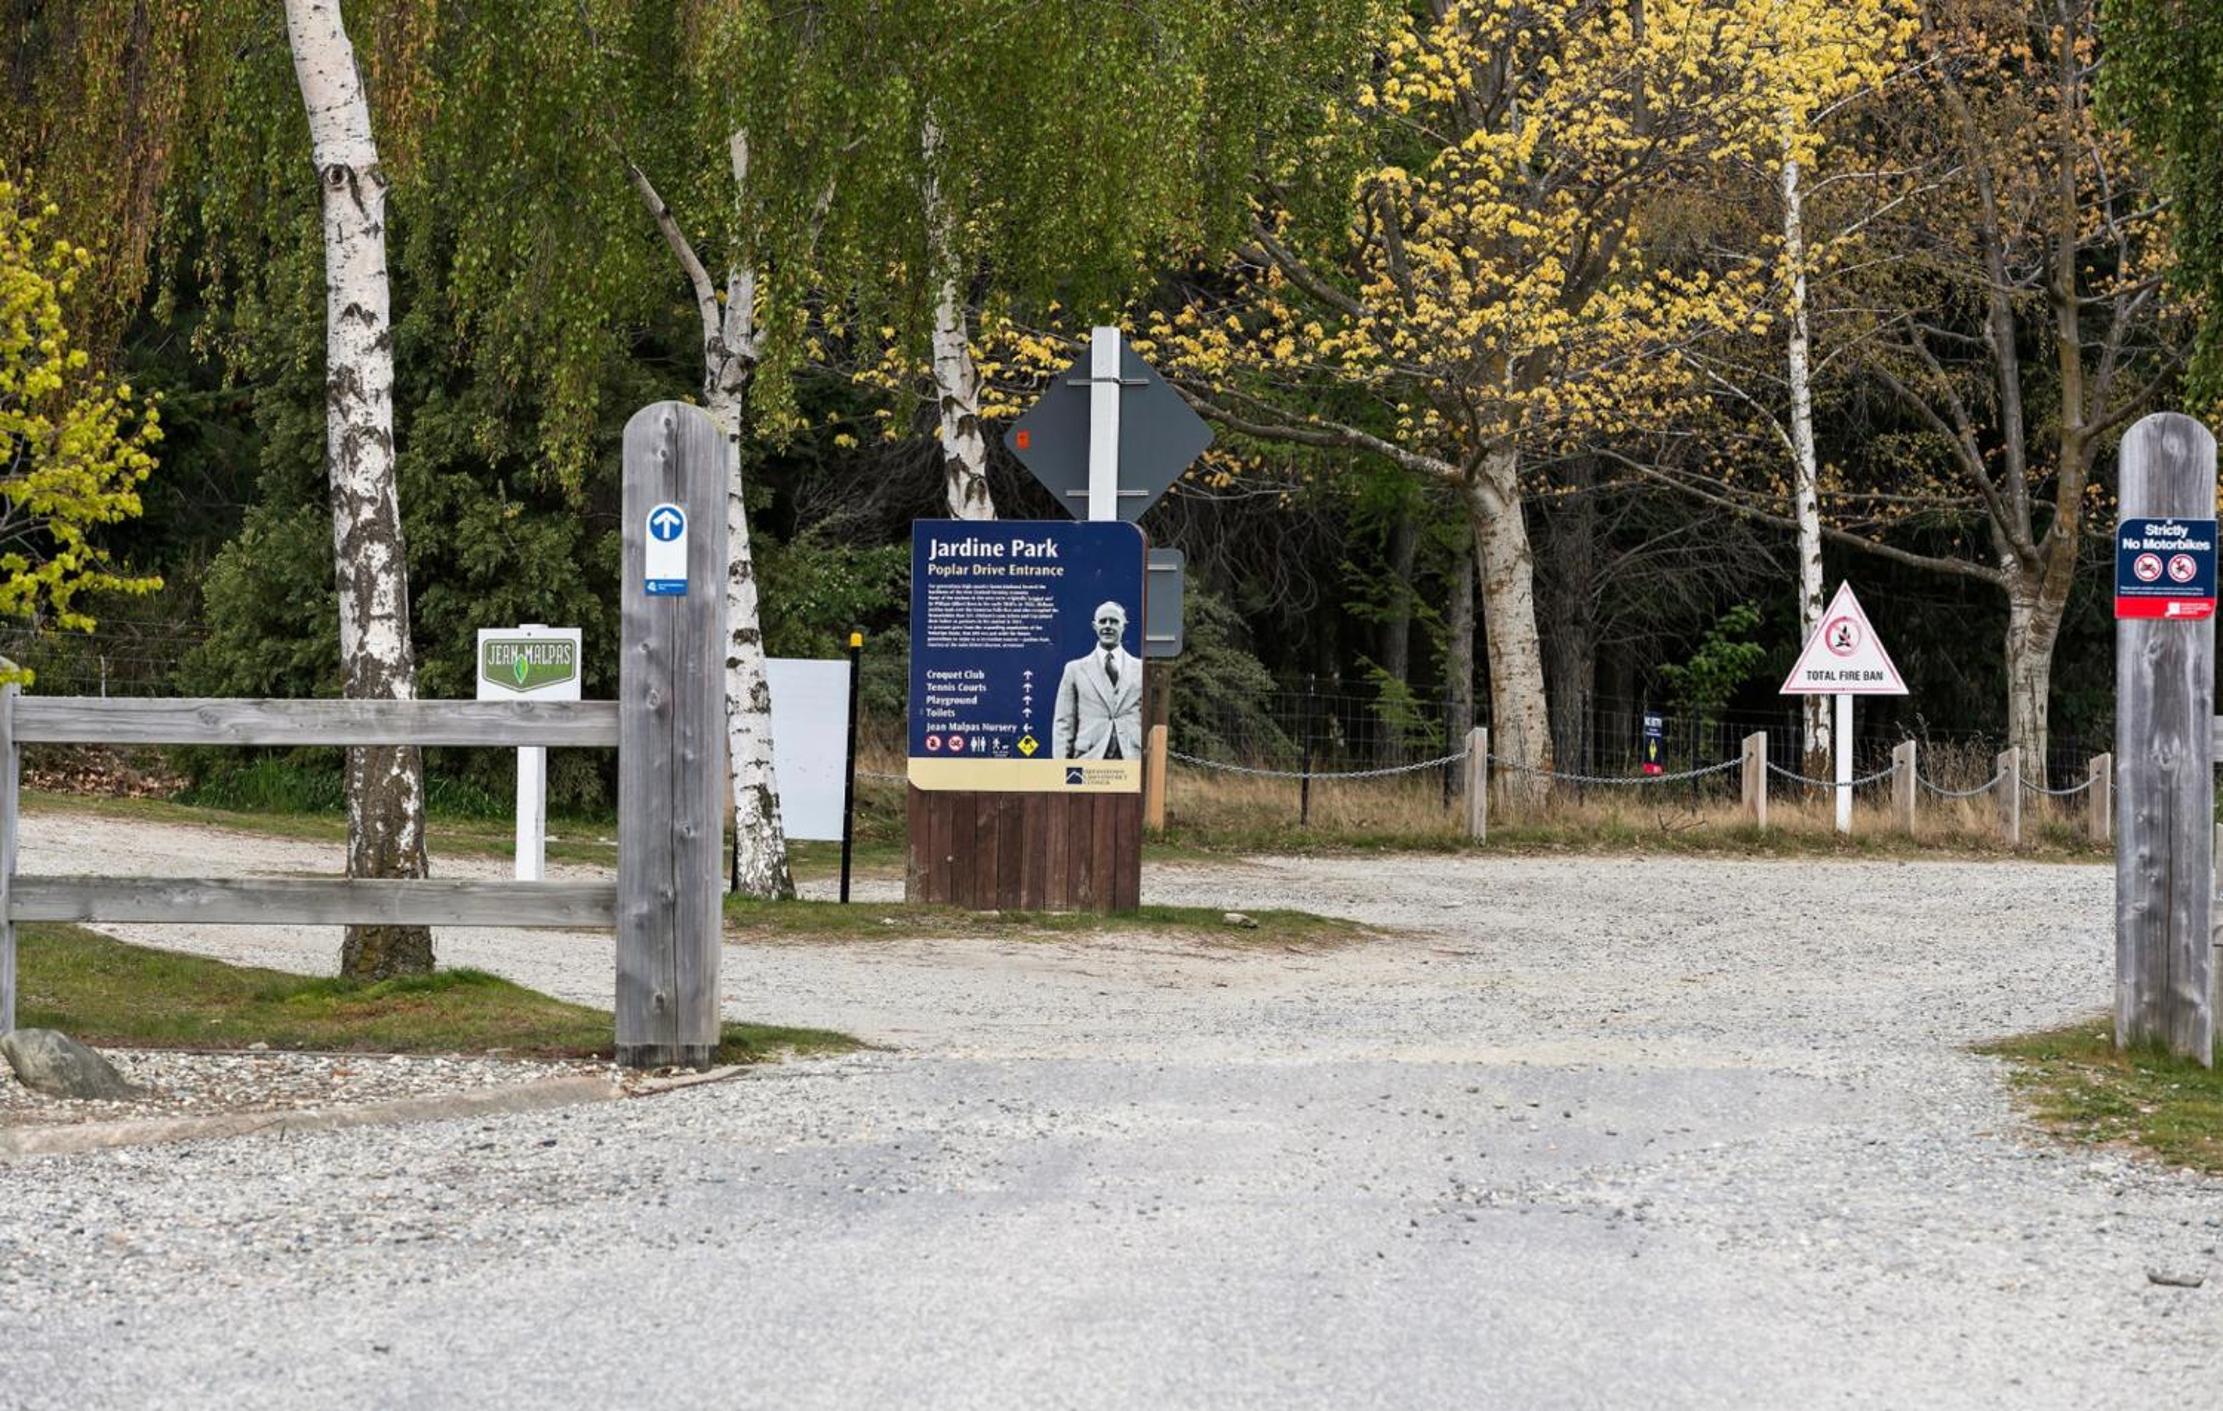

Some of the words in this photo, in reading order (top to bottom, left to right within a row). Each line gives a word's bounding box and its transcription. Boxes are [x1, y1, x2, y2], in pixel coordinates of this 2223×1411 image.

[2145, 524, 2189, 539] Strictly
[929, 538, 1005, 560] Jardine
[1011, 538, 1059, 558] Park
[2122, 538, 2141, 550] No
[2142, 538, 2211, 551] Motorbikes
[928, 563, 969, 577] Poplar
[973, 563, 1006, 576] Drive
[1009, 564, 1064, 577] Entrance
[488, 644, 518, 665] JEAN
[524, 644, 571, 665] MALPAS
[926, 670, 963, 682] Croquet
[964, 669, 985, 680] Club
[1807, 670, 1836, 681] TOTAL
[1839, 670, 1861, 681] FIRE
[1863, 670, 1883, 681] BAN
[926, 682, 956, 693] Tennis
[958, 682, 987, 693] Courts
[926, 695, 978, 707] Playground
[926, 707, 956, 718] Toilets
[926, 722, 947, 733] Jean
[949, 721, 981, 734] Malpas
[982, 722, 1018, 734] Nursery
